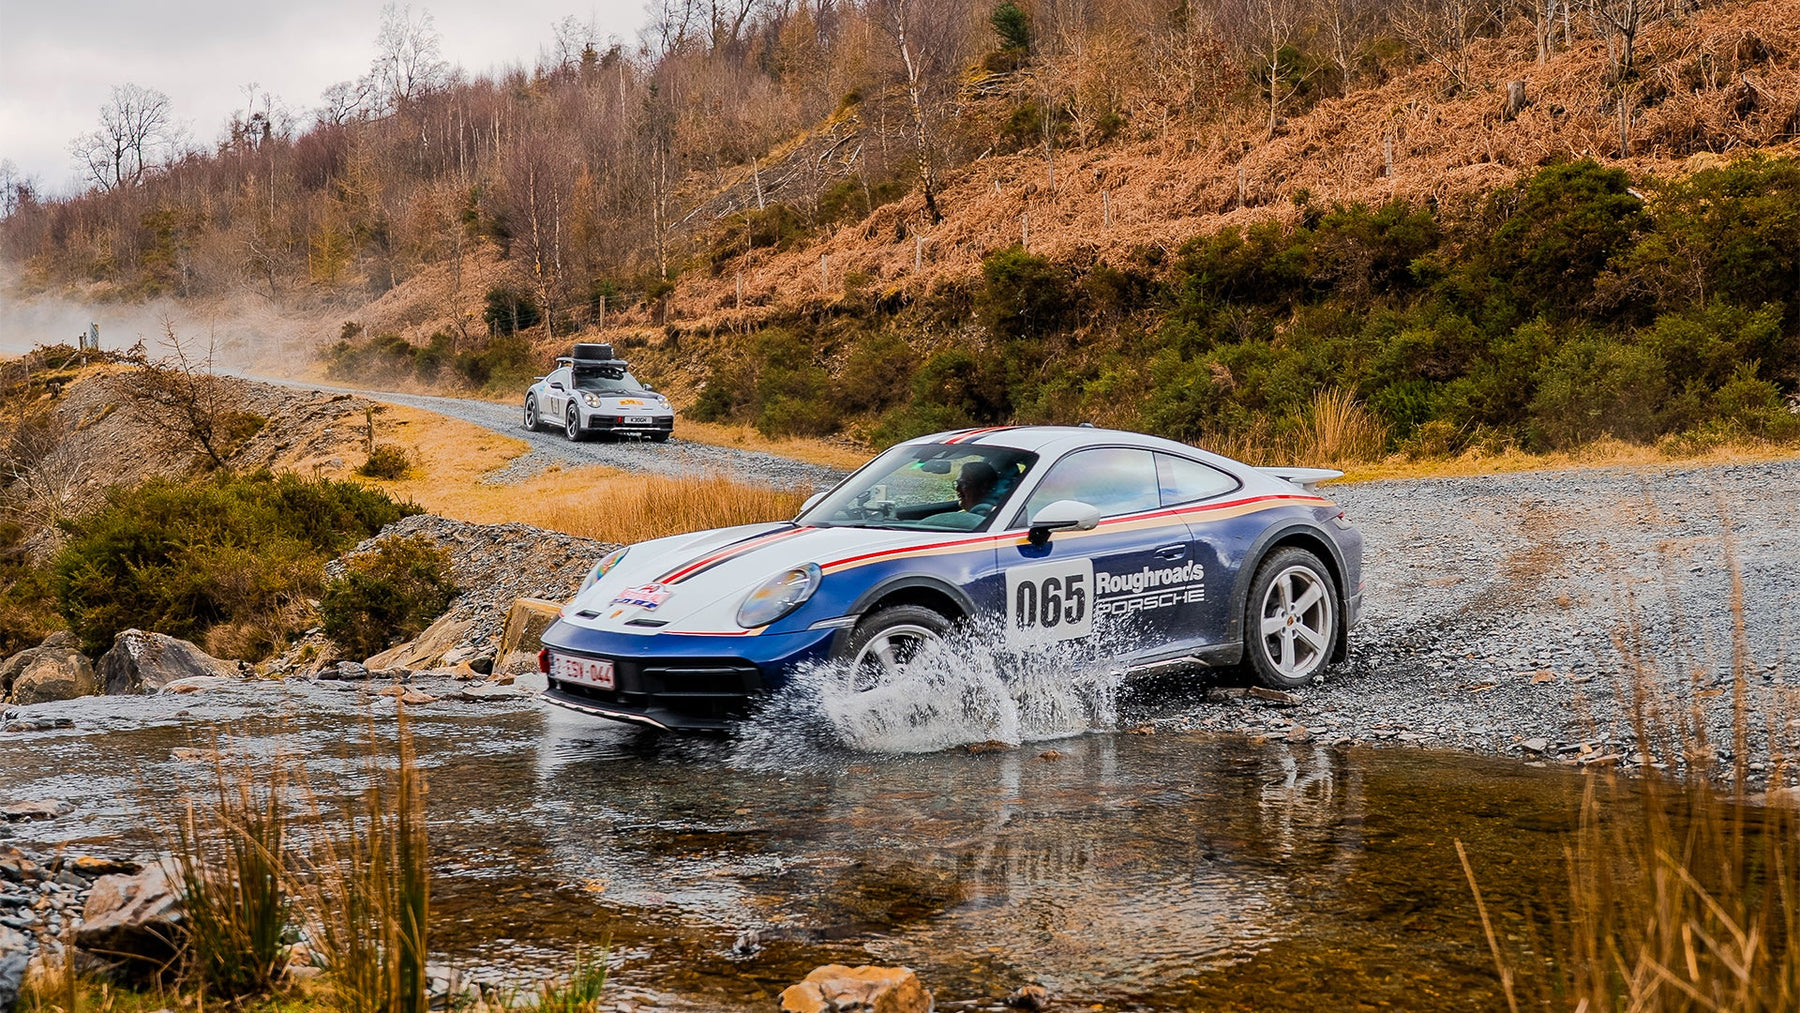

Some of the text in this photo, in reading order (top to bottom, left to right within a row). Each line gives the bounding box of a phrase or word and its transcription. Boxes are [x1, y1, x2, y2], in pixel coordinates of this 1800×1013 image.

[1095, 560, 1205, 594] Roughroads
[1015, 574, 1086, 632] 065
[1097, 588, 1205, 614] PORSCHE
